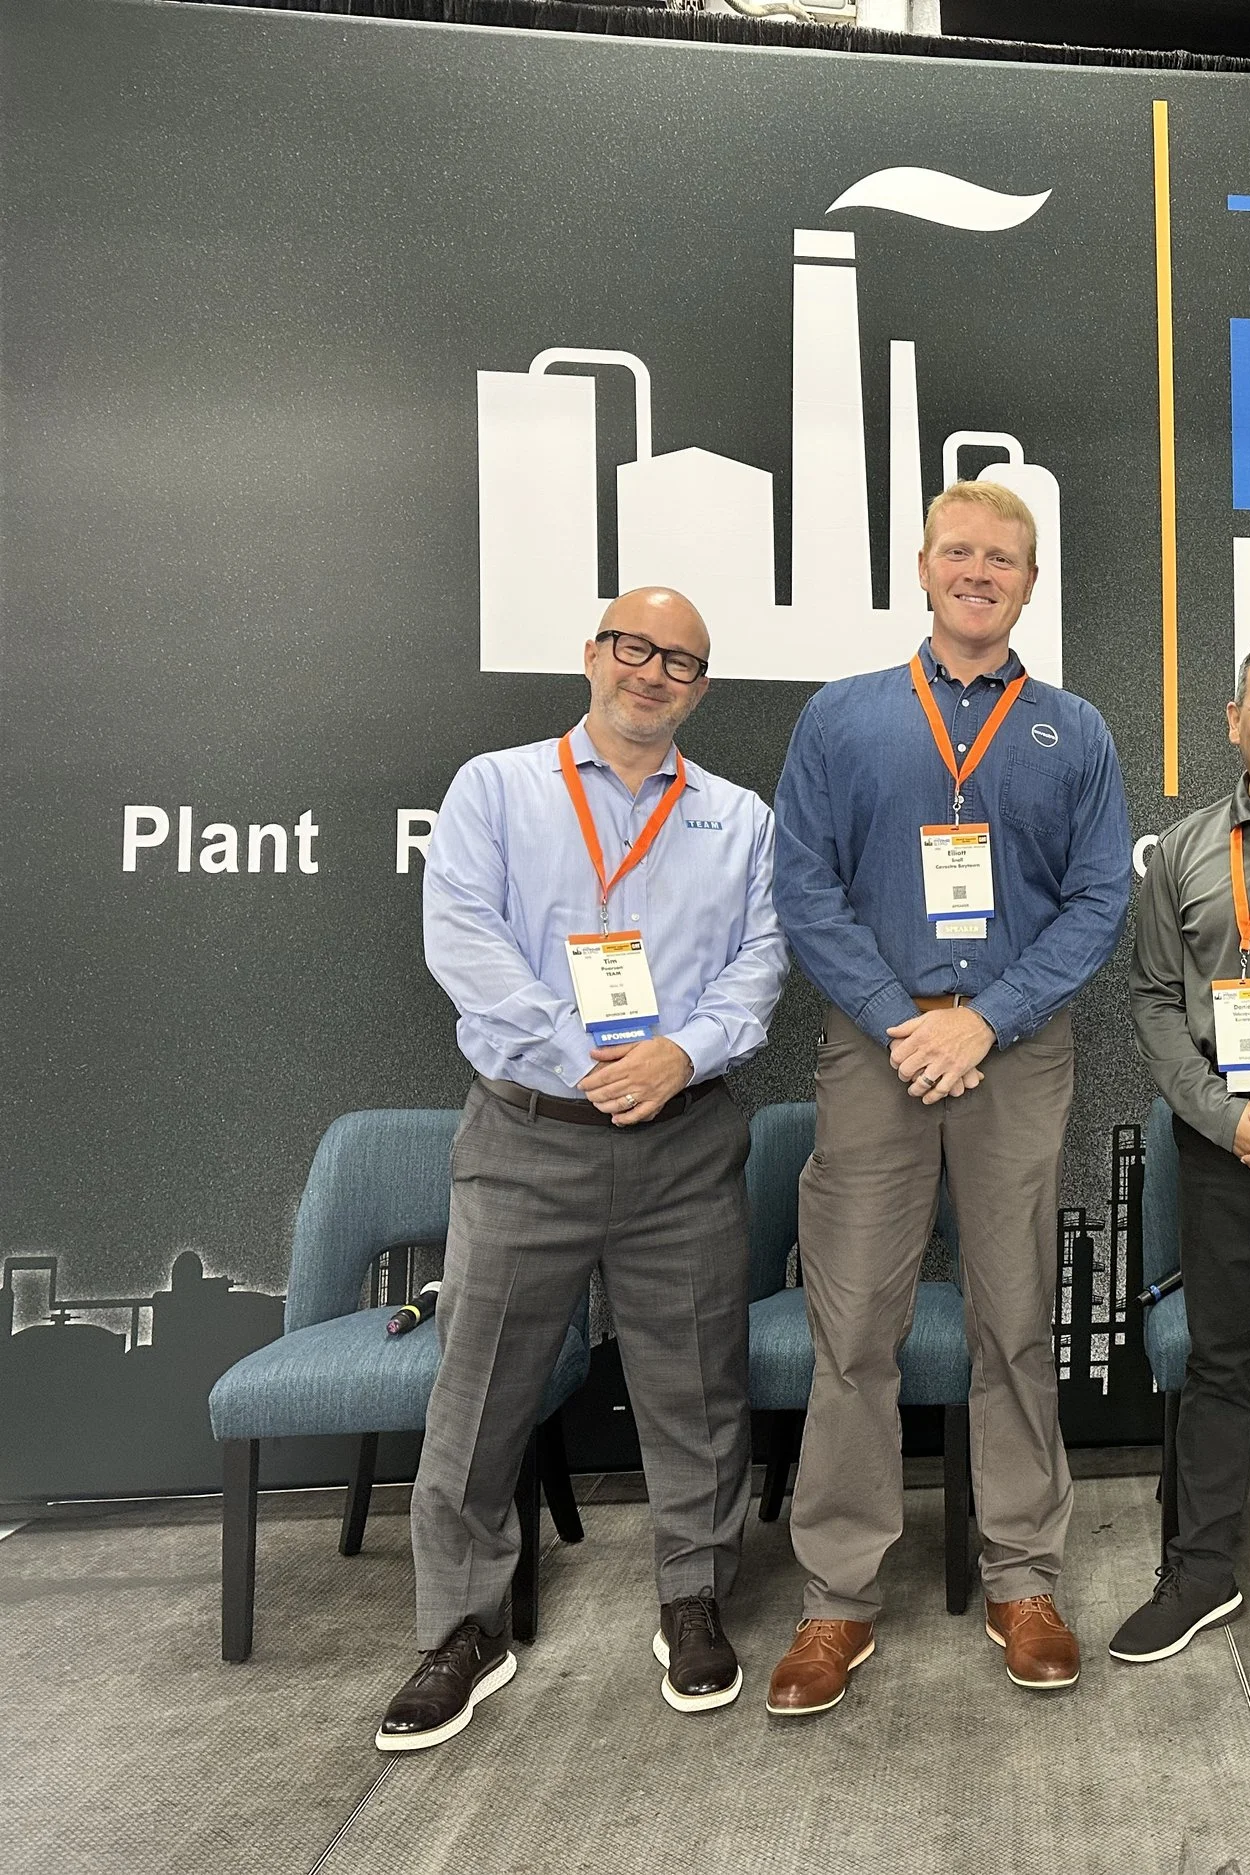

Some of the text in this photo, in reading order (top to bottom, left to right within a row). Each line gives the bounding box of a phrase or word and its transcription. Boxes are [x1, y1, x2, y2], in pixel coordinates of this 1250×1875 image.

[687, 820, 721, 830] TEAM
[122, 805, 319, 874] Plant
[601, 1030, 646, 1042] SPONSOR
